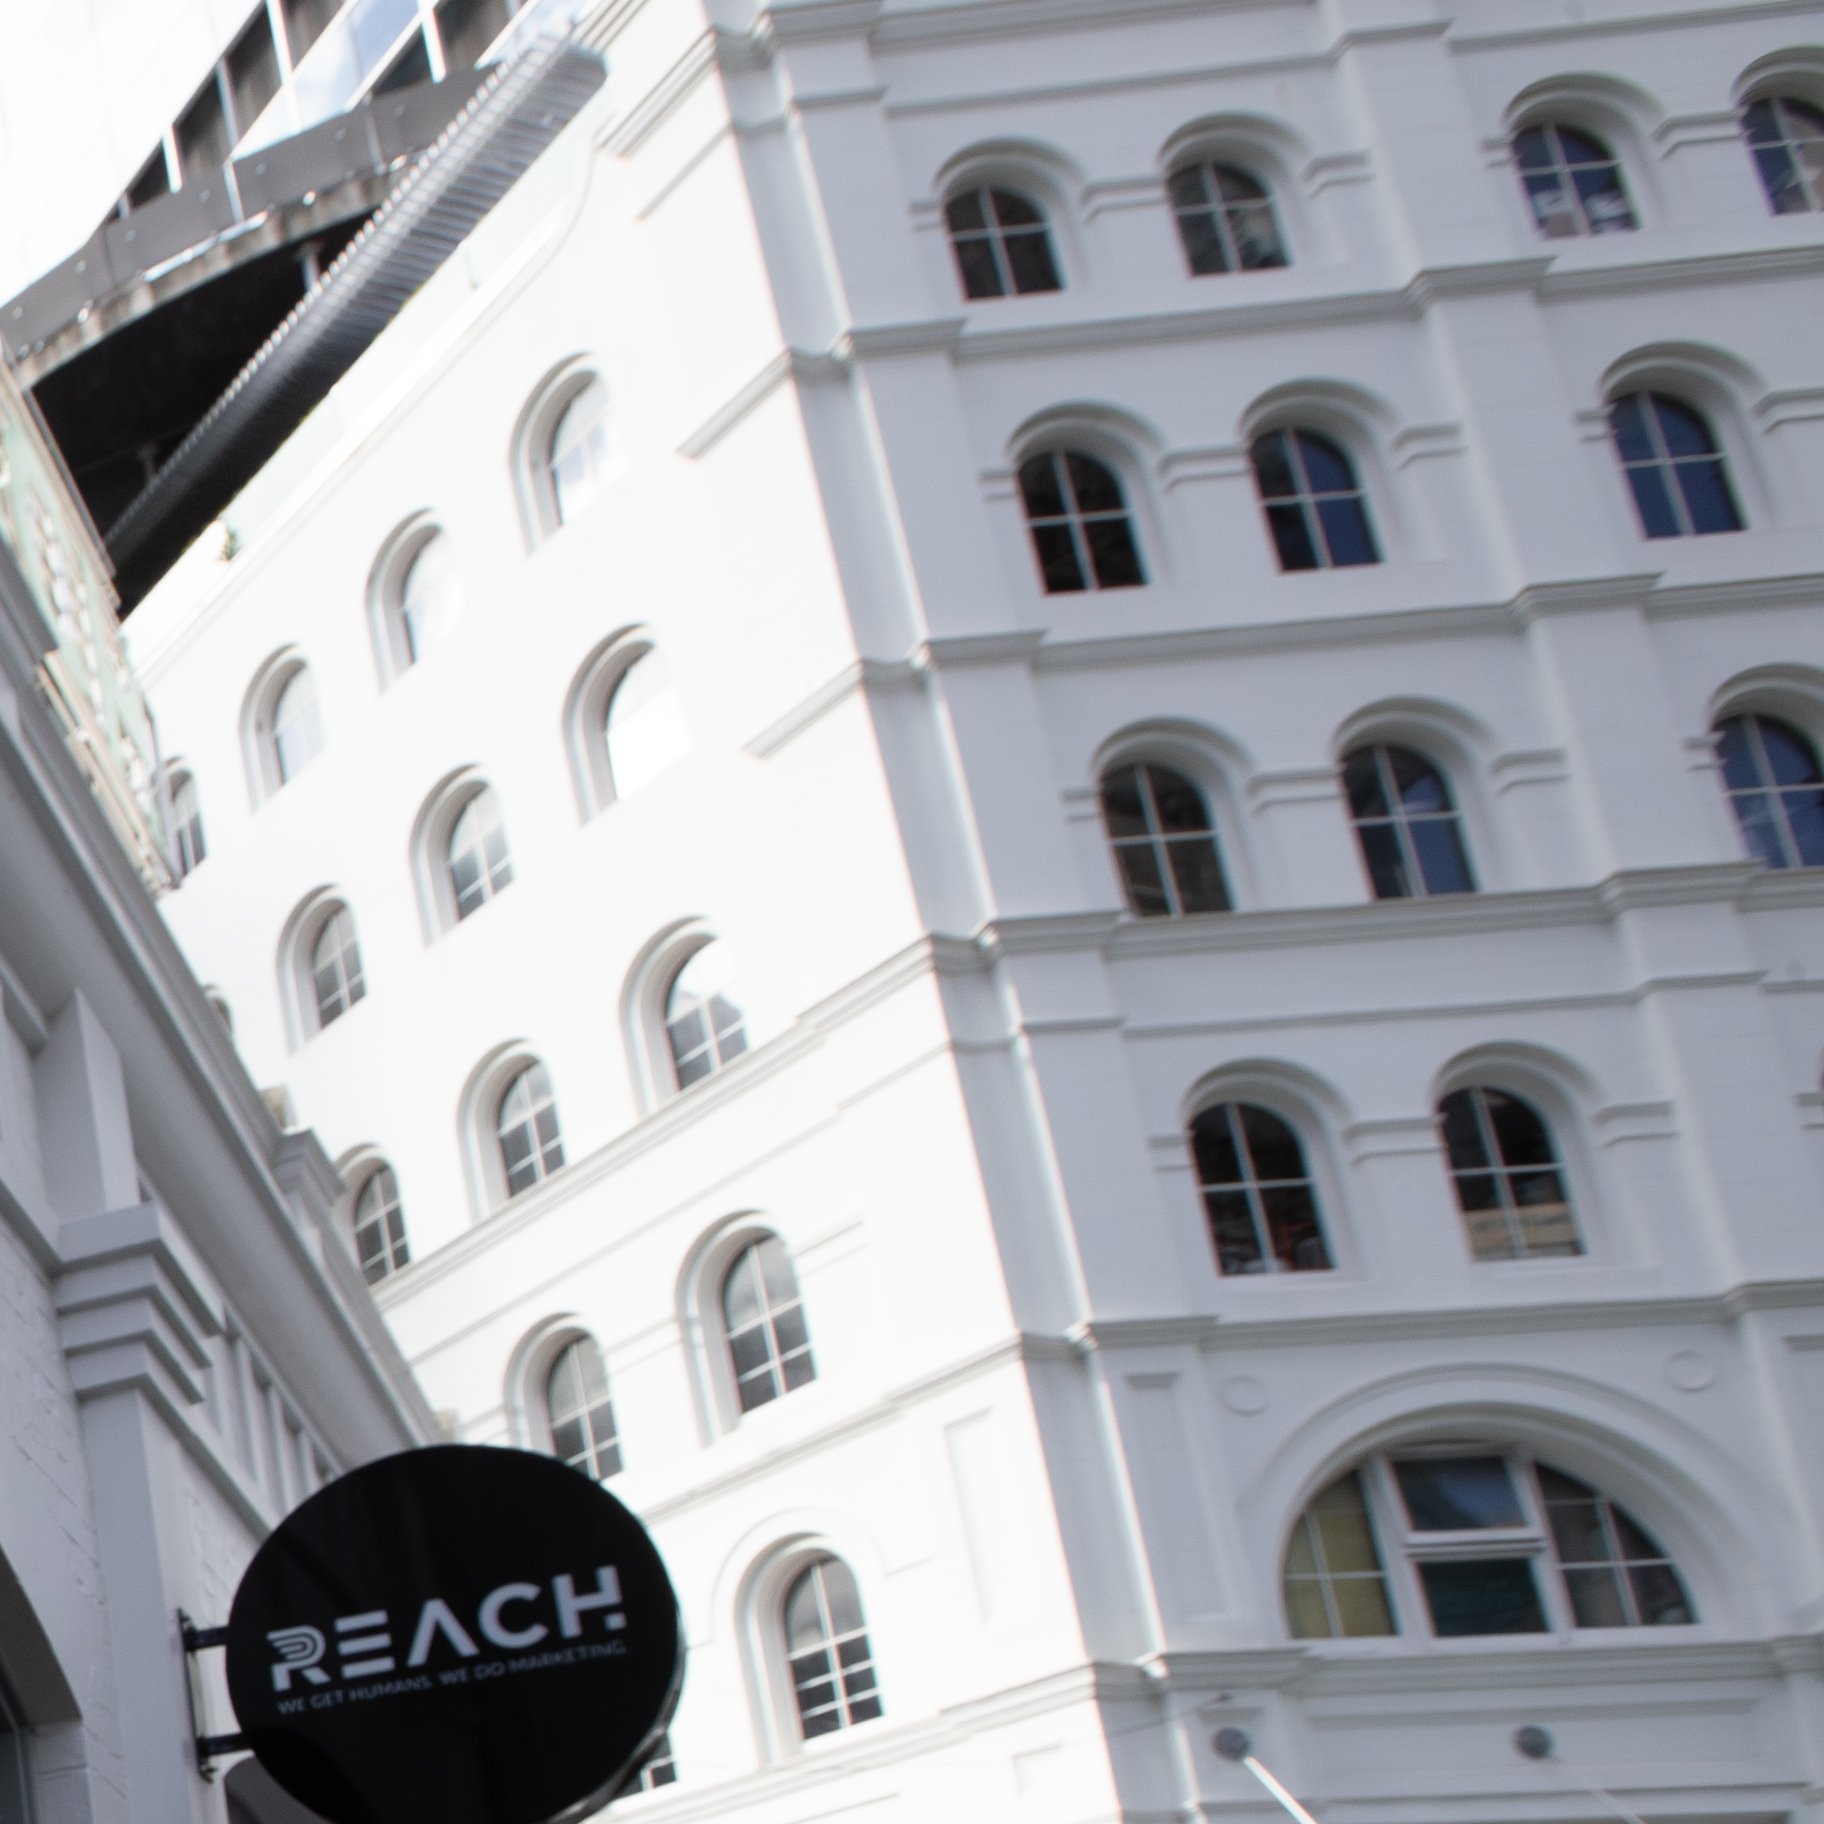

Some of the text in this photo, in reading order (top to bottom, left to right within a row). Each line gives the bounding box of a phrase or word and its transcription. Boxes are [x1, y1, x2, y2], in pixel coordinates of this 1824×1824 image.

[266, 1565, 627, 1692] REACH
[277, 1697, 306, 1715] WE
[309, 1688, 345, 1710] GET
[437, 1666, 468, 1687] WE
[473, 1660, 506, 1680] DO
